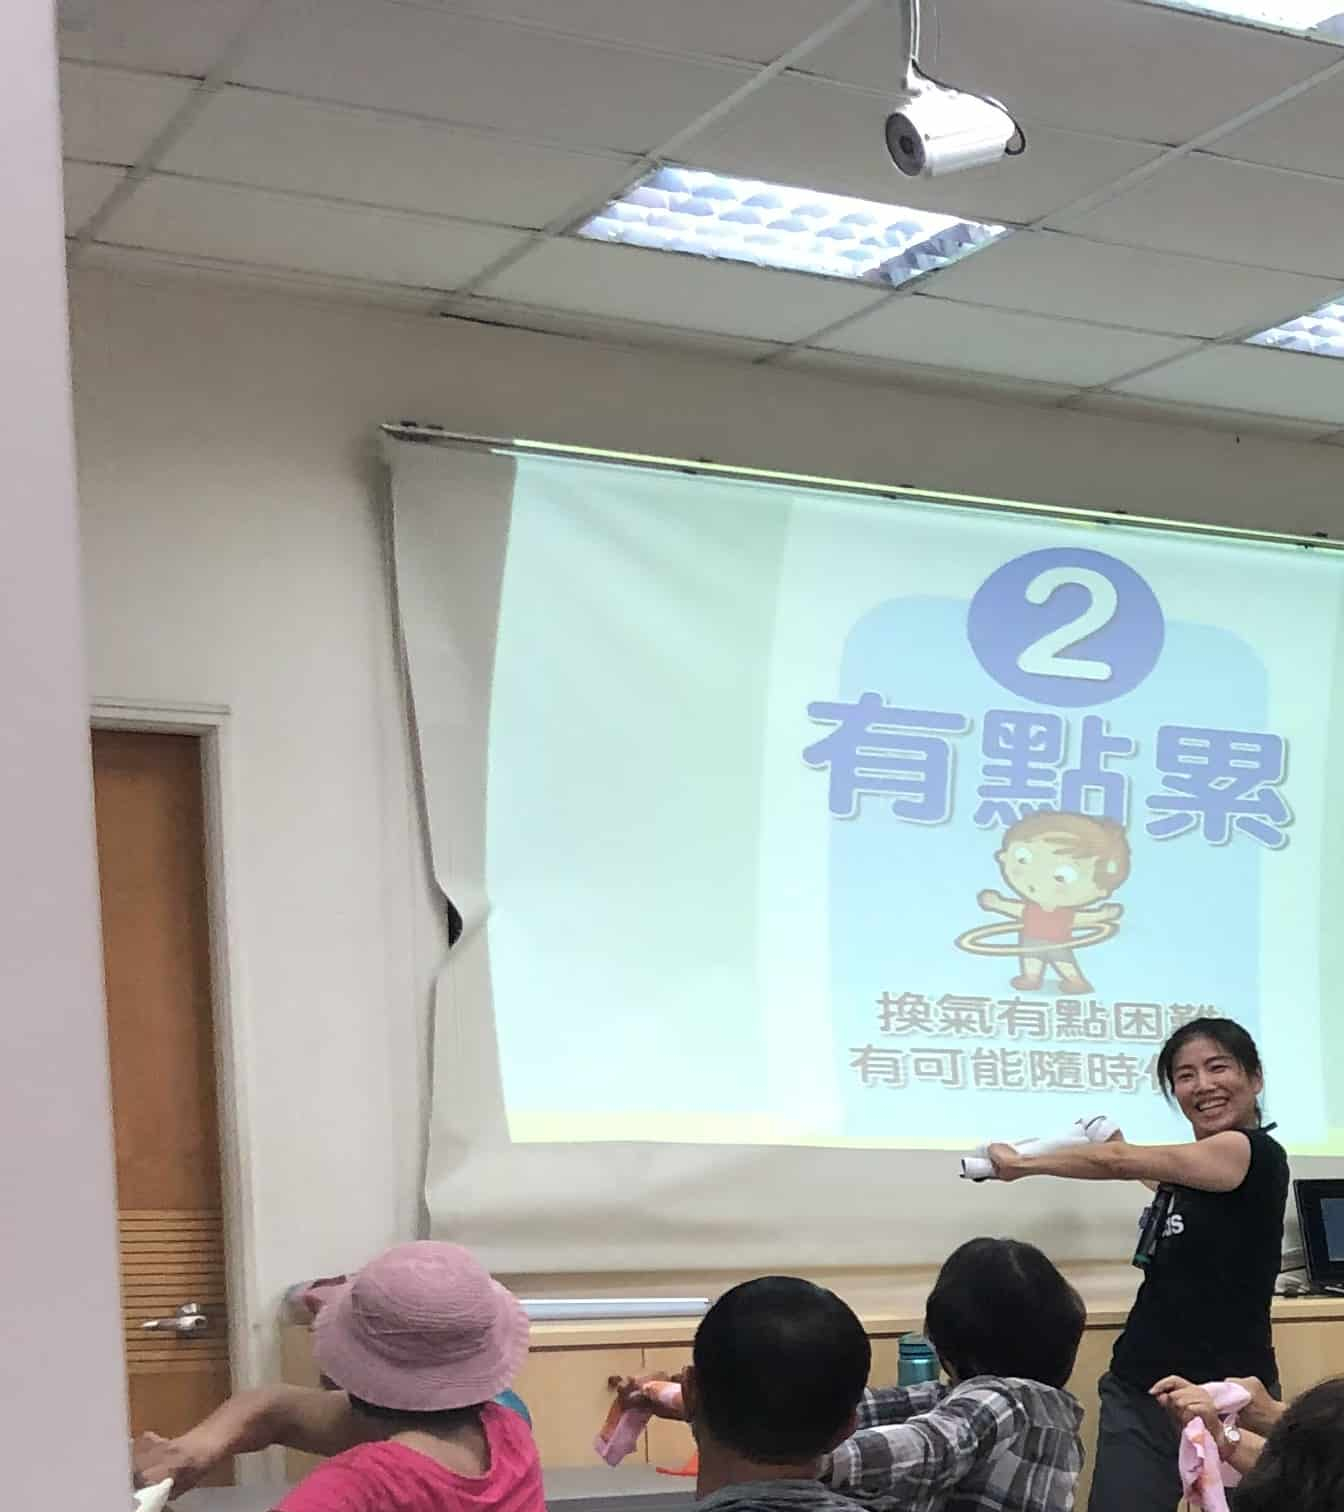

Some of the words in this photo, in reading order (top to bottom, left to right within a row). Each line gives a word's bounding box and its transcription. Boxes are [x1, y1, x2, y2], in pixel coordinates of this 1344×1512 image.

[1016, 566, 1118, 681] 2
[802, 692, 1294, 848] 有點累
[849, 1044, 1163, 1092] 有可能隨時
